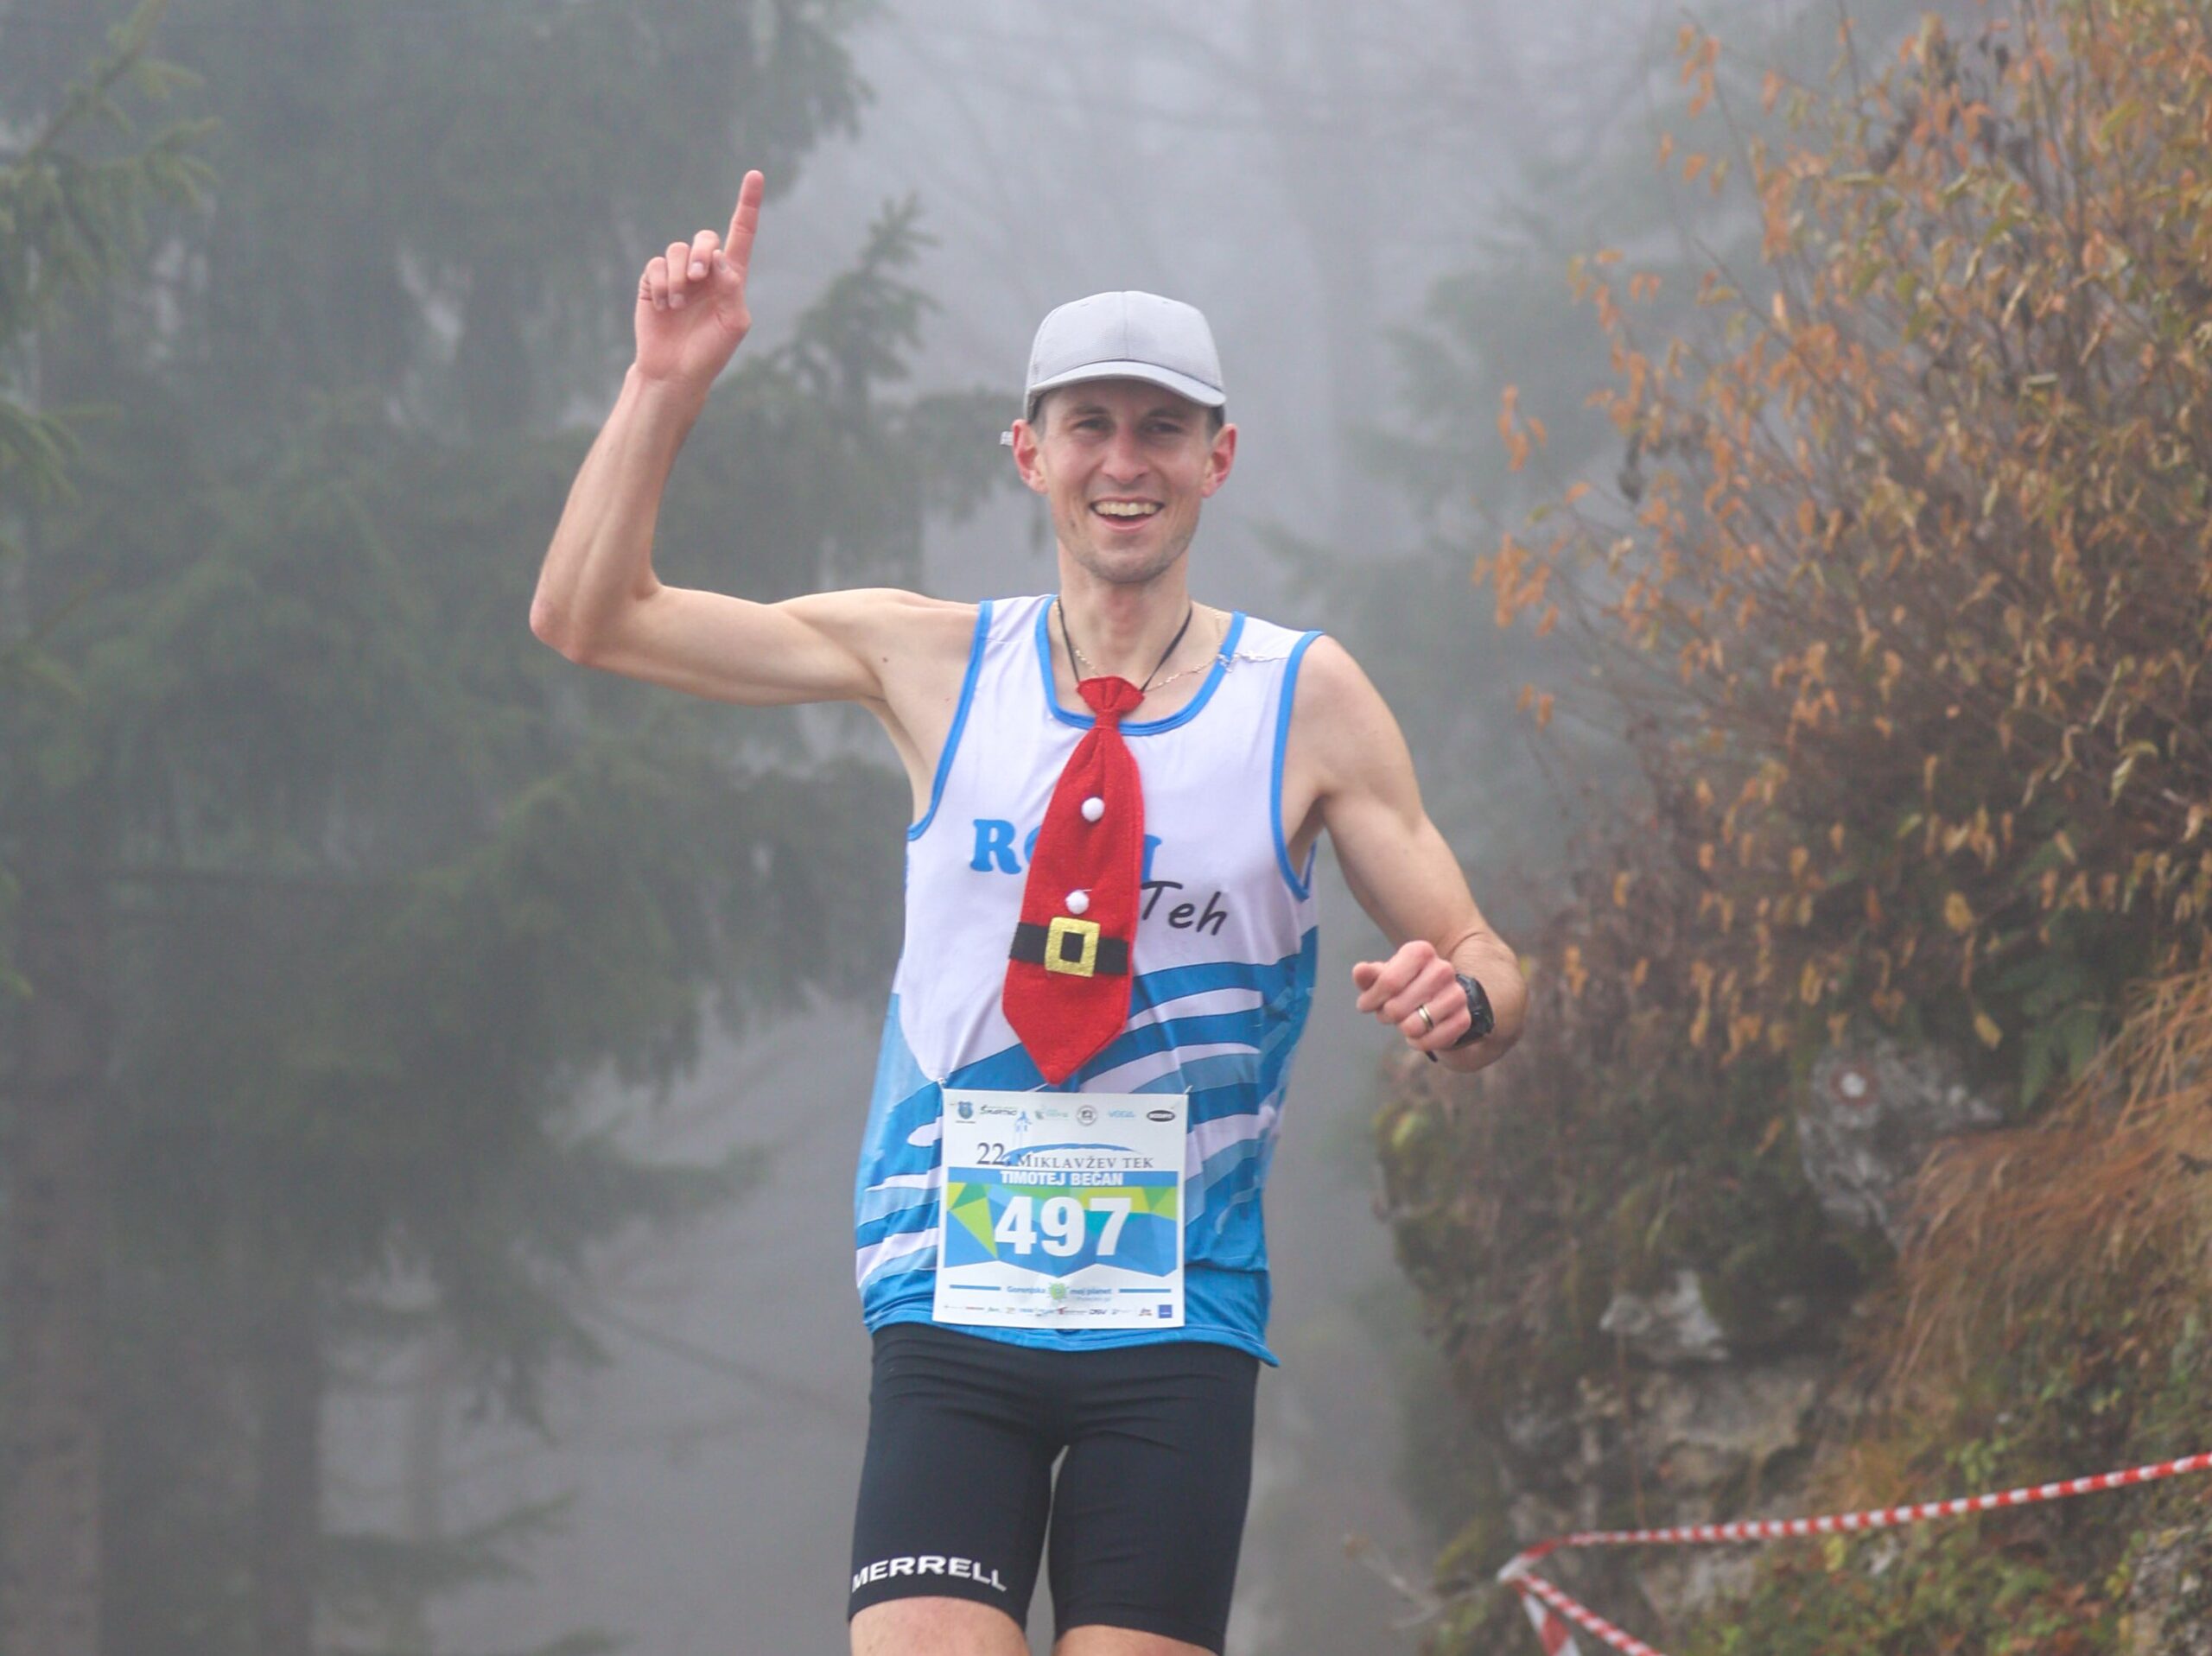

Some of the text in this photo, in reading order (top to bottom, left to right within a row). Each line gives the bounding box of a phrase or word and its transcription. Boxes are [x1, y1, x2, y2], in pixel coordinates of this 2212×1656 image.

[1140, 880, 1228, 936] Teh
[1000, 1171, 1066, 1186] TIMOTEJ
[1017, 1154, 1116, 1170] MIKLAVŽEV
[1122, 1157, 1154, 1169] TEK
[995, 1196, 1132, 1257] 497
[851, 1555, 1007, 1593] MERRELL
